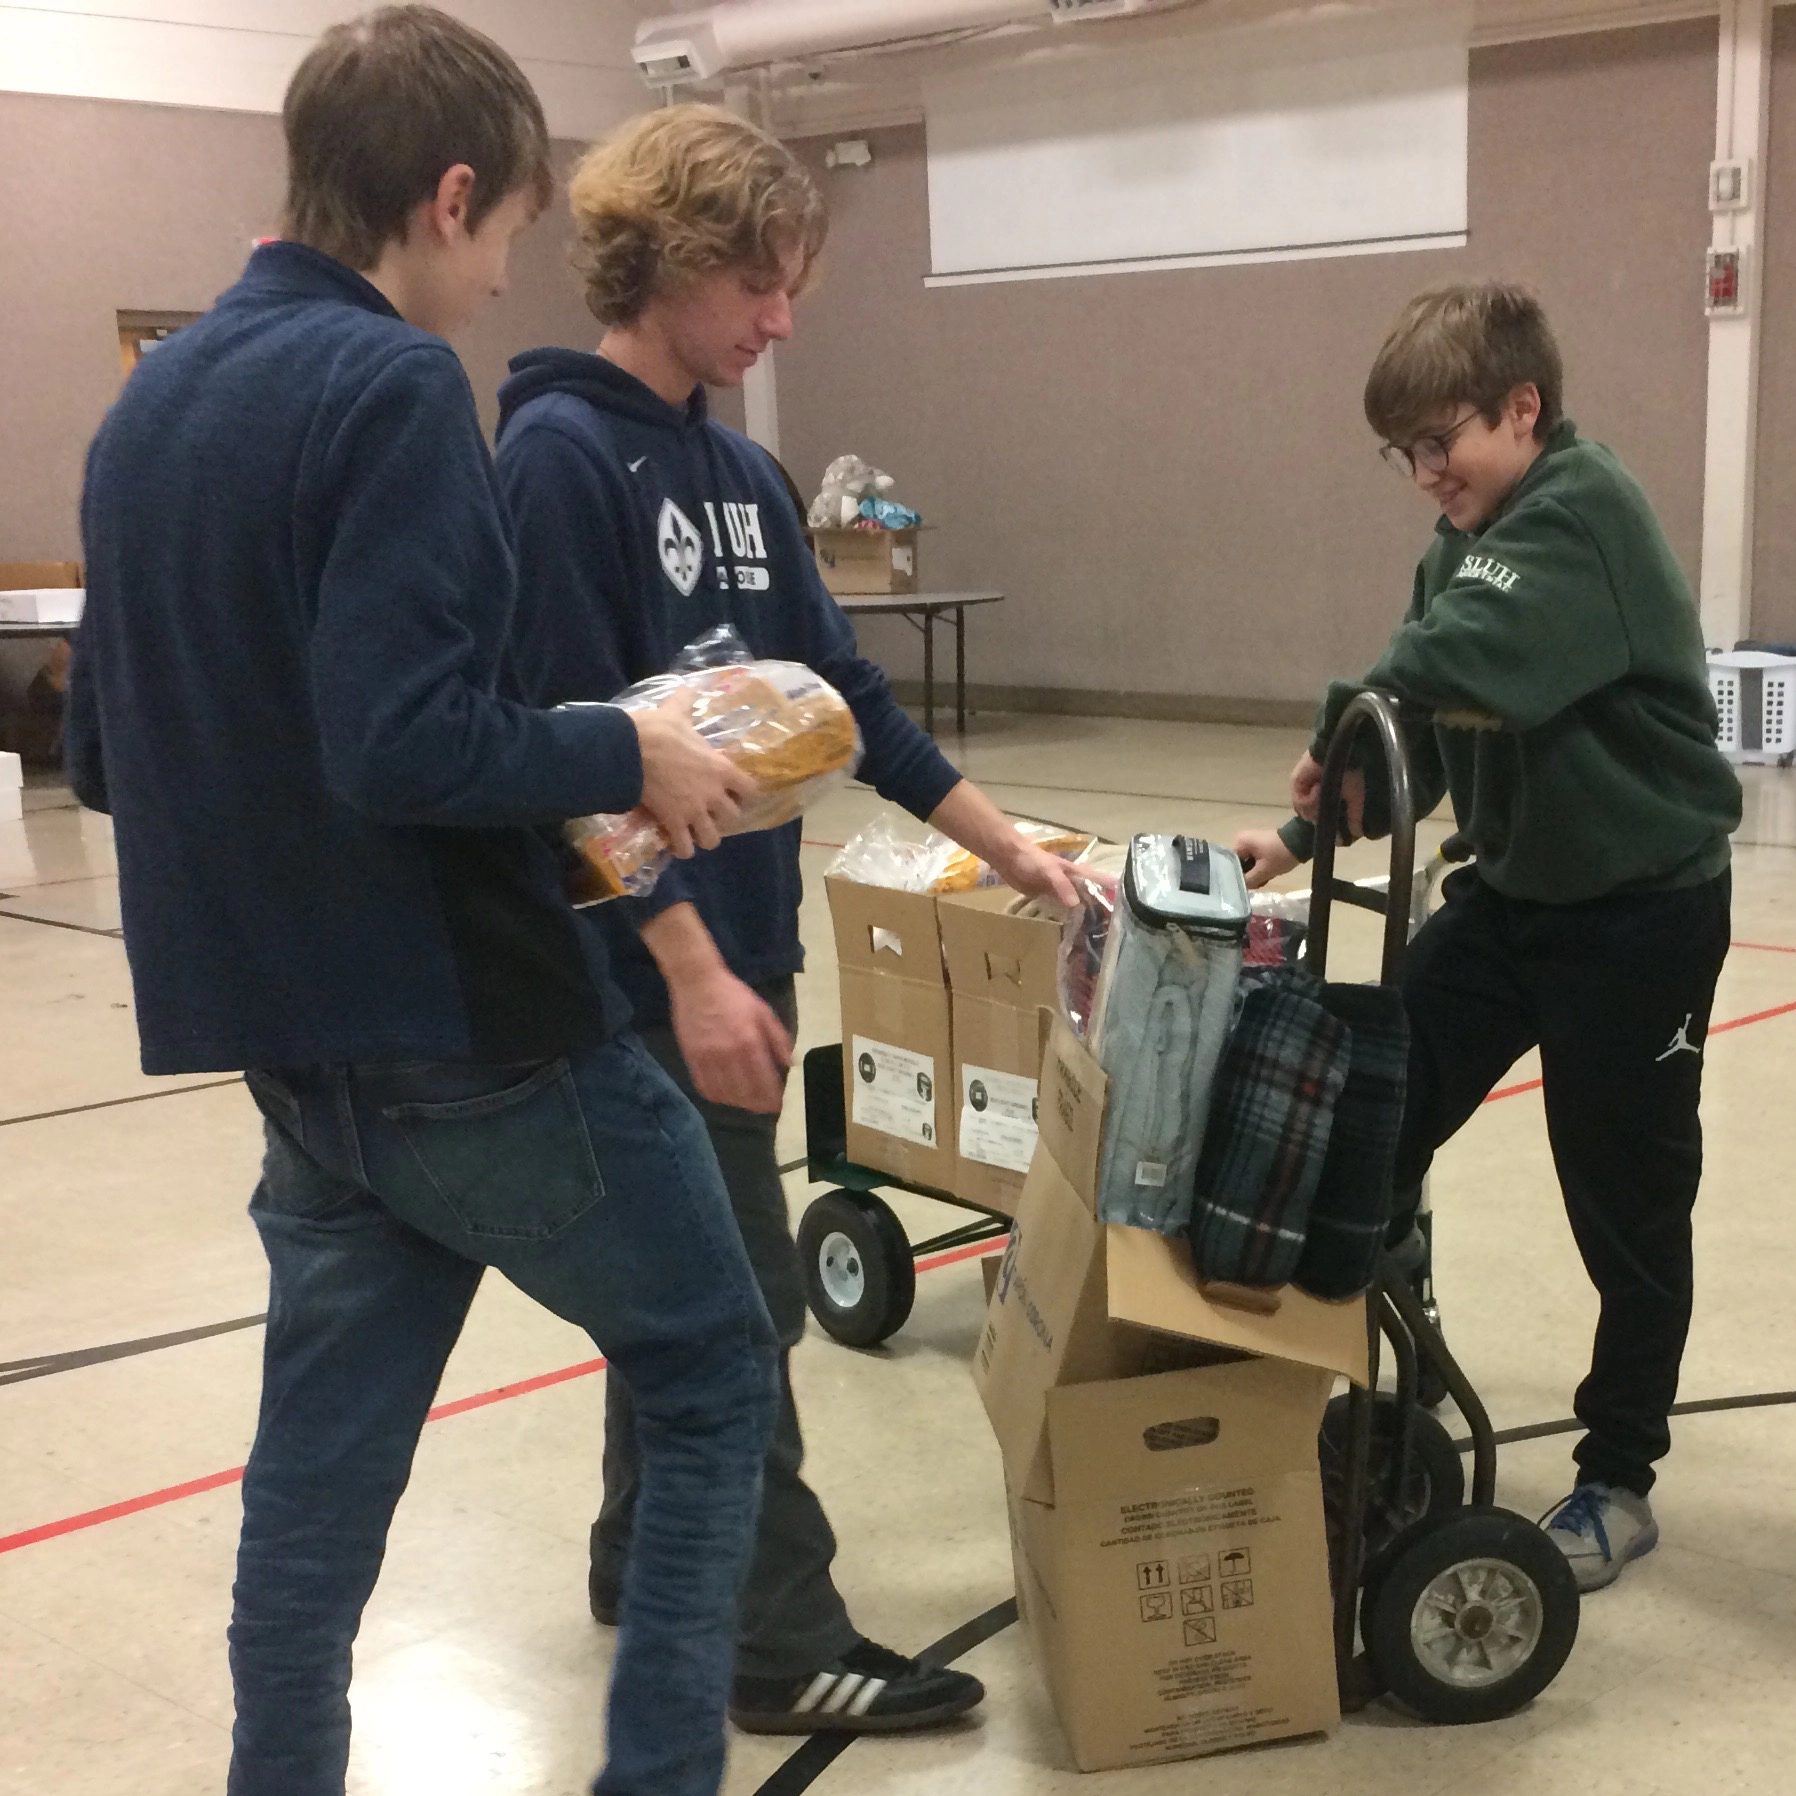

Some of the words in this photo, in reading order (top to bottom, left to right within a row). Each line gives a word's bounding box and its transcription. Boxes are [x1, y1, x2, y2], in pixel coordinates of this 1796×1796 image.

[1461, 555, 1521, 590] SLUH
[1207, 1487, 1255, 1502] COUNTED
[1100, 1536, 1140, 1548] CANTIDAD
